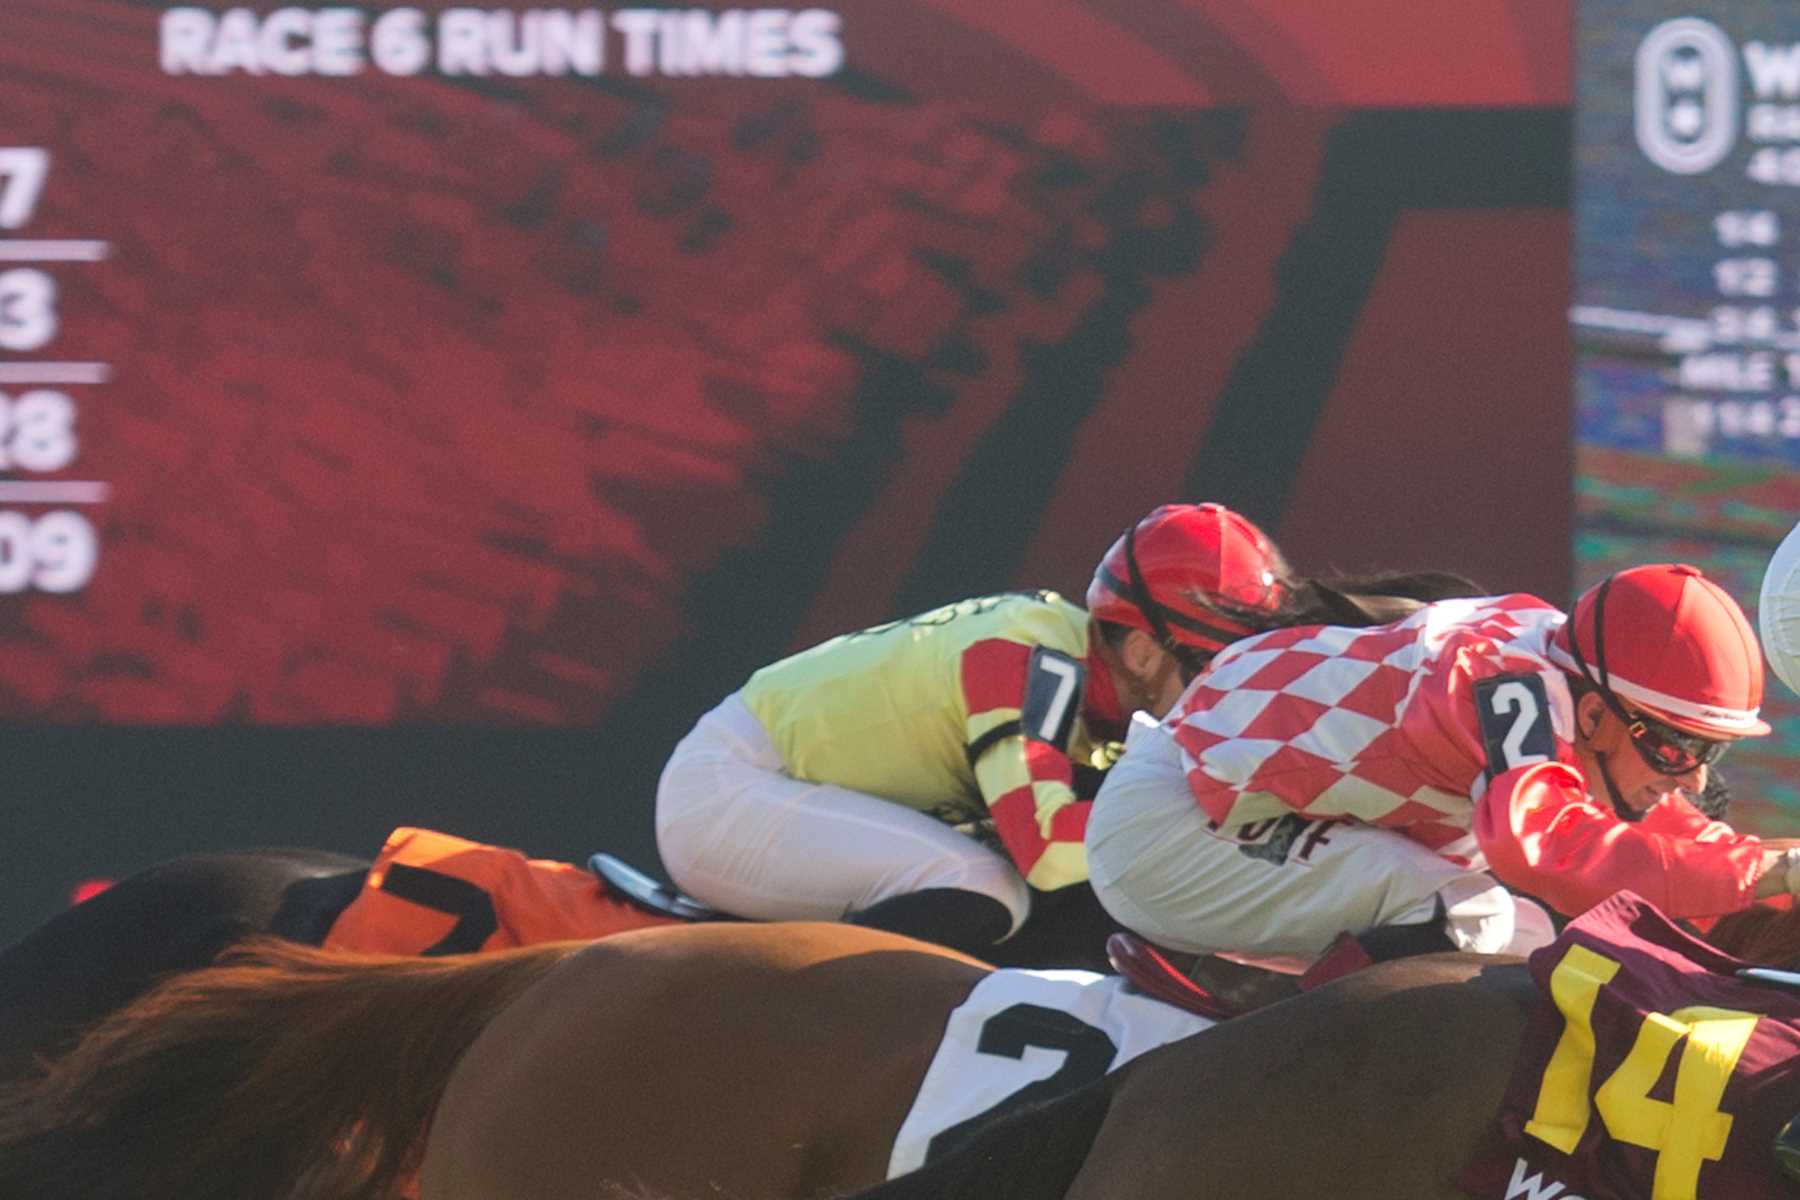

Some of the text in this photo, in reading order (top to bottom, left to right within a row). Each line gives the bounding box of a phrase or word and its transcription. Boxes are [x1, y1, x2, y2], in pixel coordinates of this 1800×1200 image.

[160, 8, 844, 76] RACE 6 RUN TIMES
[0, 146, 51, 229] 7
[0, 267, 57, 351] 3
[0, 389, 78, 473] 8
[1038, 654, 1077, 741] 7
[1491, 681, 1549, 768] 2
[379, 861, 498, 957] 7
